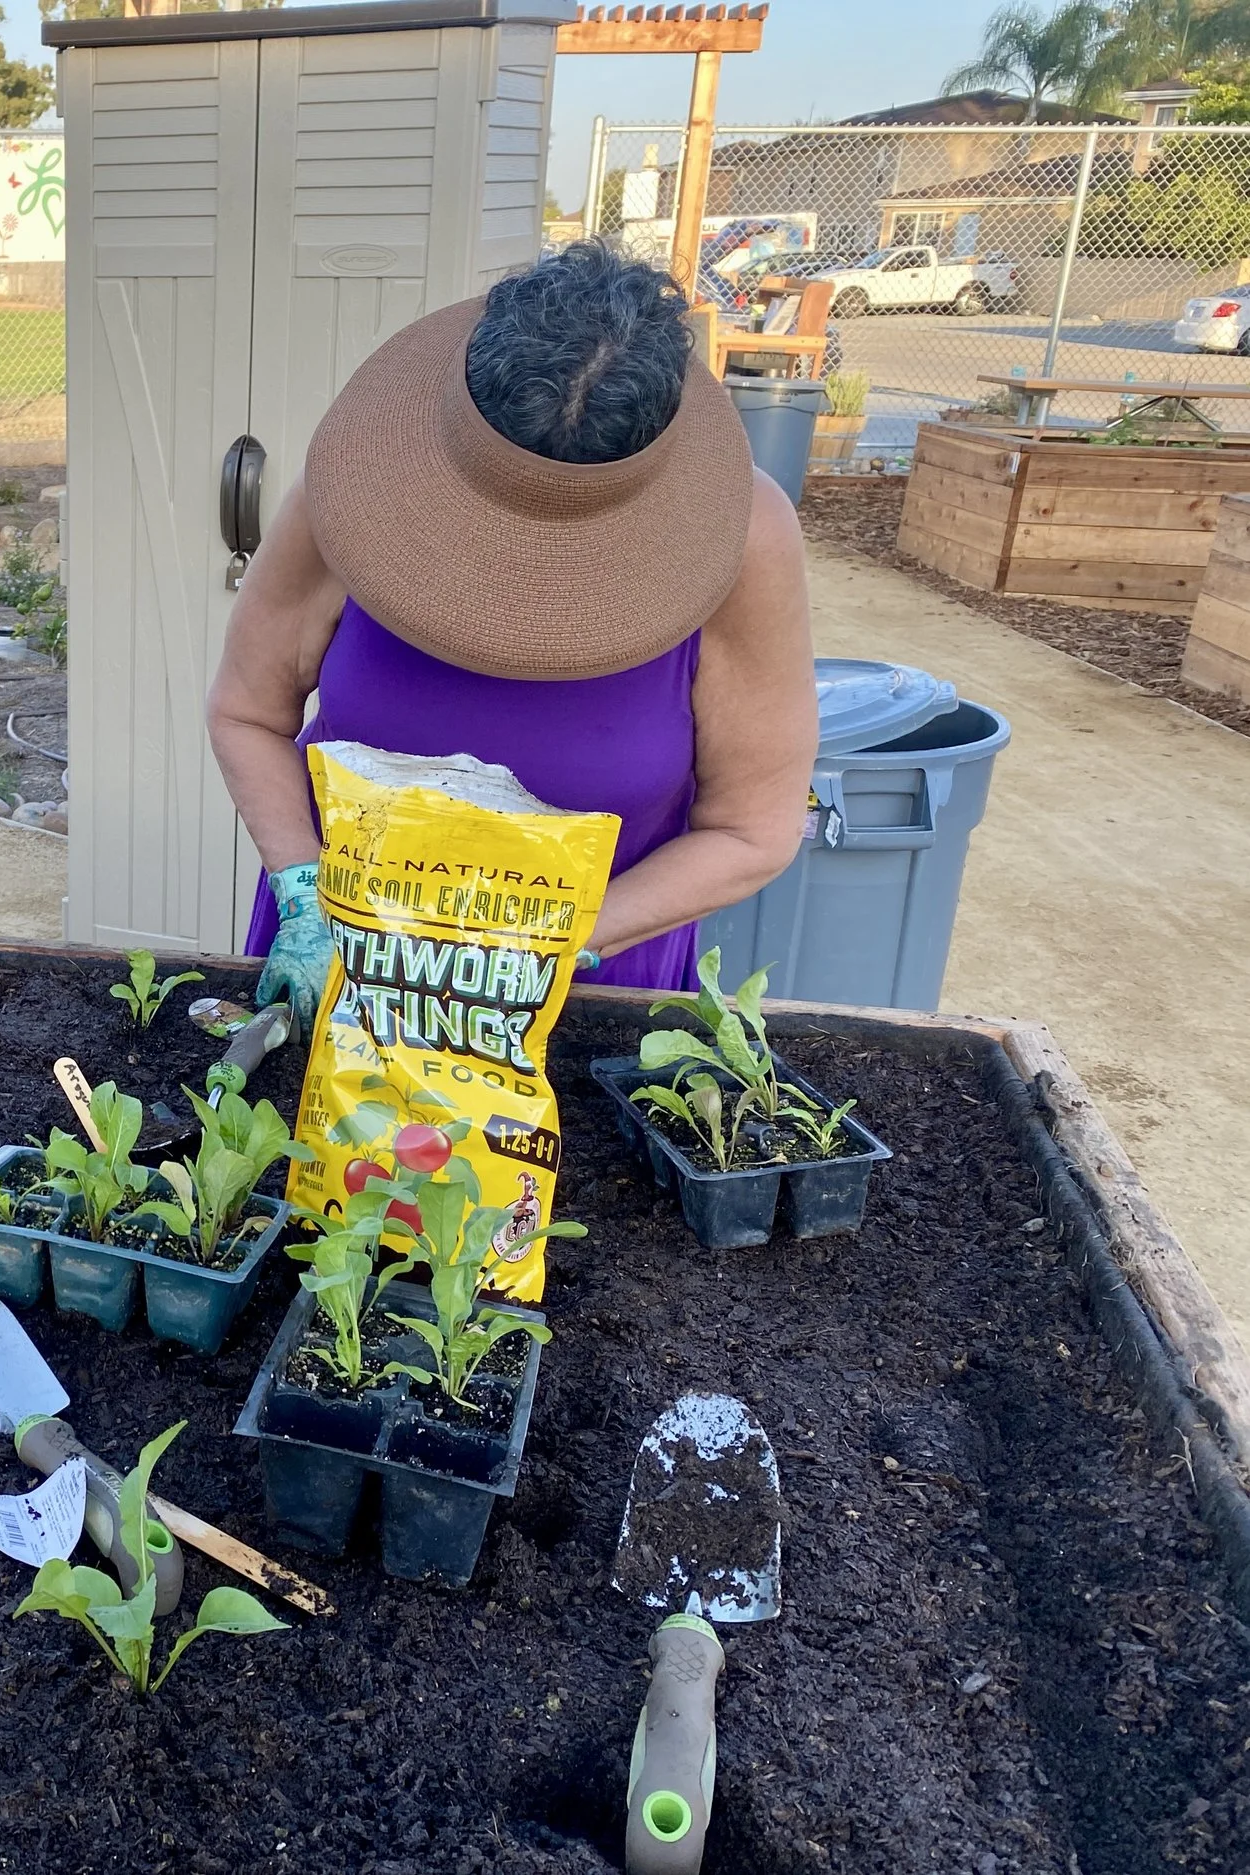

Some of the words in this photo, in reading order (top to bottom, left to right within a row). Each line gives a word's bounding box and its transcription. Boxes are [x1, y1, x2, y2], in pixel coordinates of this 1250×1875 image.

[338, 844, 576, 890] ALL-NATURAL
[365, 876, 426, 912] SOIL
[437, 885, 576, 931] ENRICHER
[330, 919, 558, 1005] RTHWORM
[422, 1060, 538, 1098] FOOD
[499, 1123, 555, 1163] 1.25-0-0
